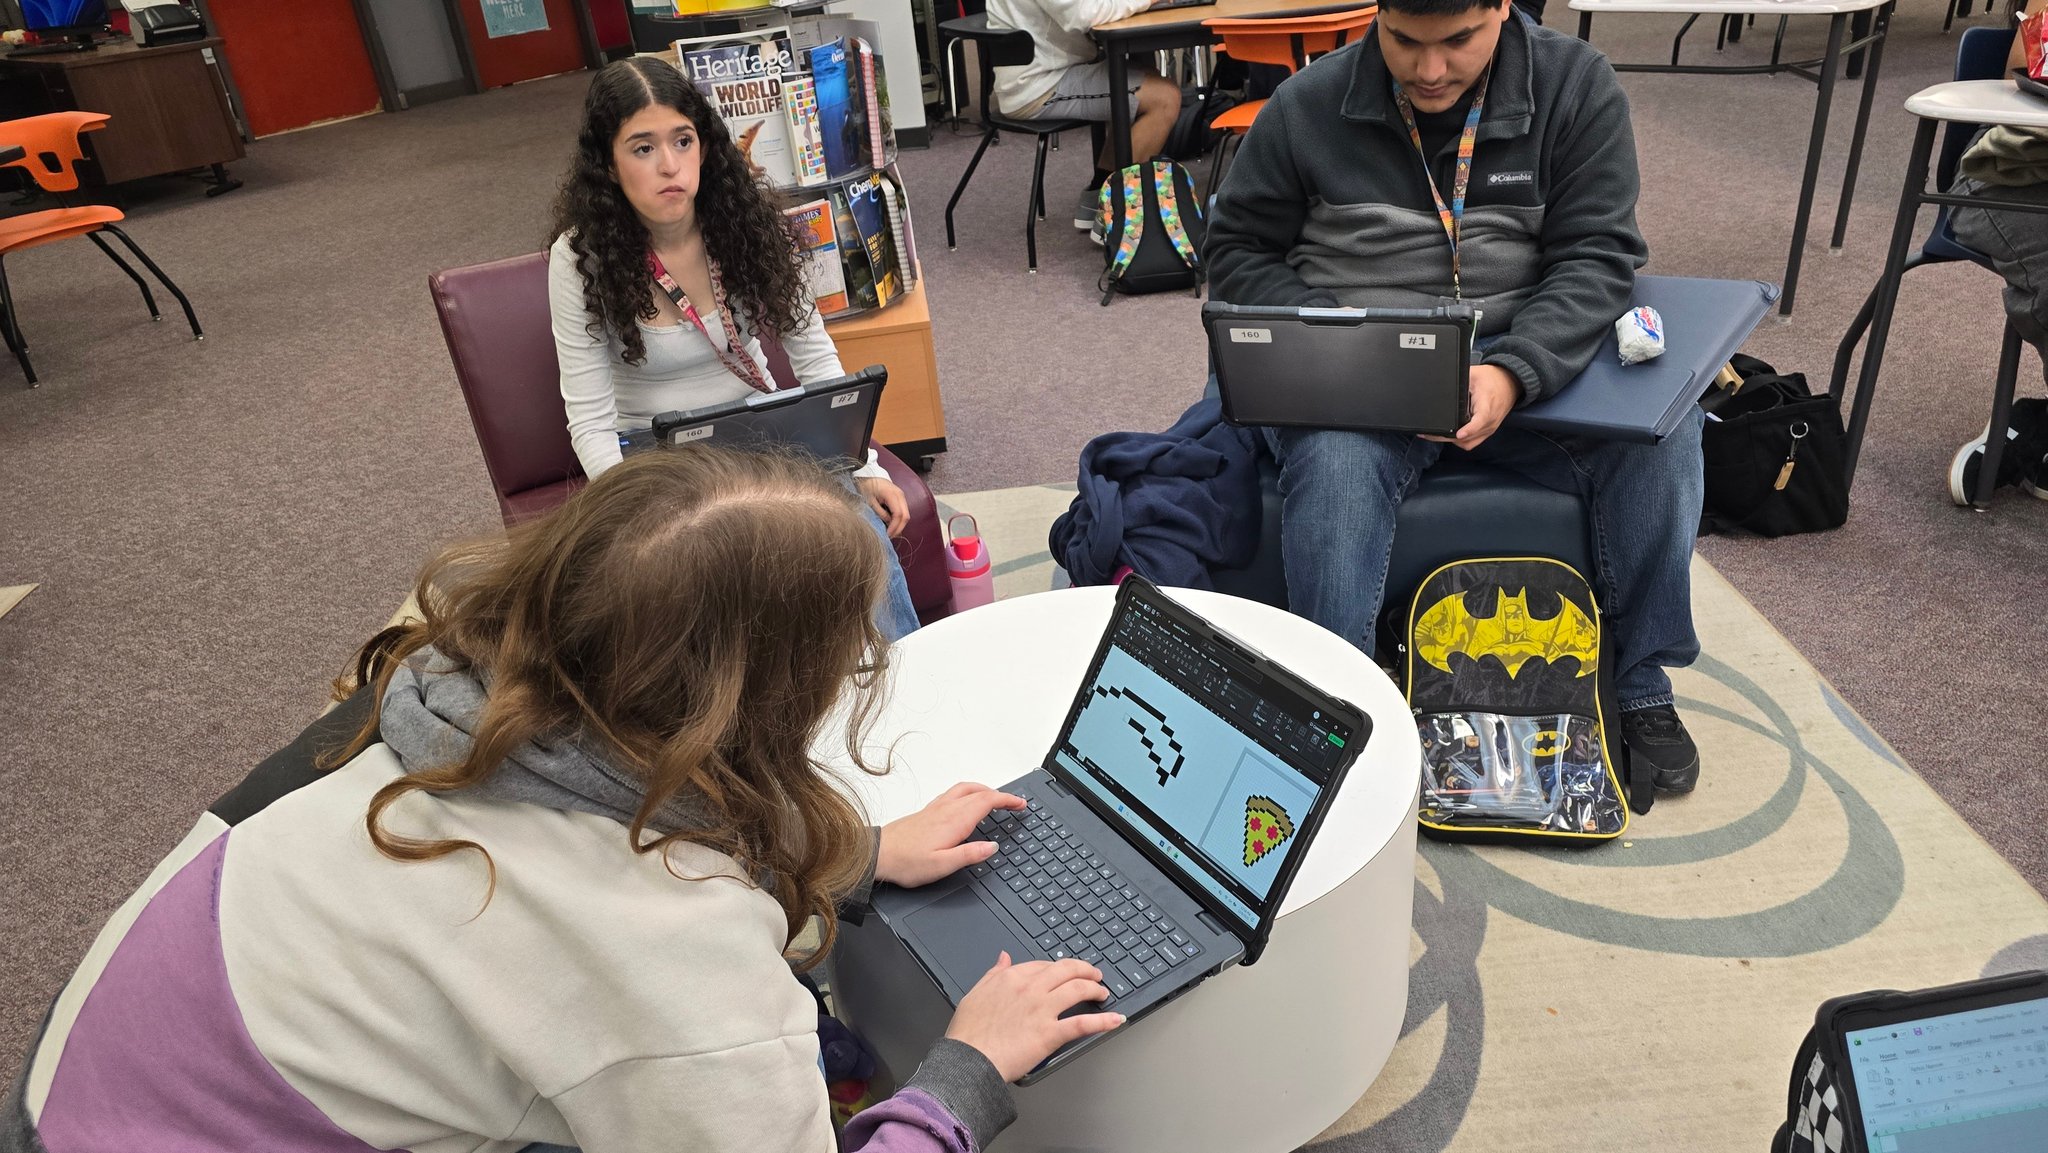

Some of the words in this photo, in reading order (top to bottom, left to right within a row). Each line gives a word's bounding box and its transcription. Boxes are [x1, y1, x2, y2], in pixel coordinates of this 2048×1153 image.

[689, 49, 792, 80] Heritage
[715, 78, 781, 104] WORLD
[1497, 173, 1532, 182] Columbia
[1241, 331, 1260, 339] 160
[1408, 336, 1428, 346] #1
[838, 393, 855, 404] #7
[686, 429, 703, 438] 160
